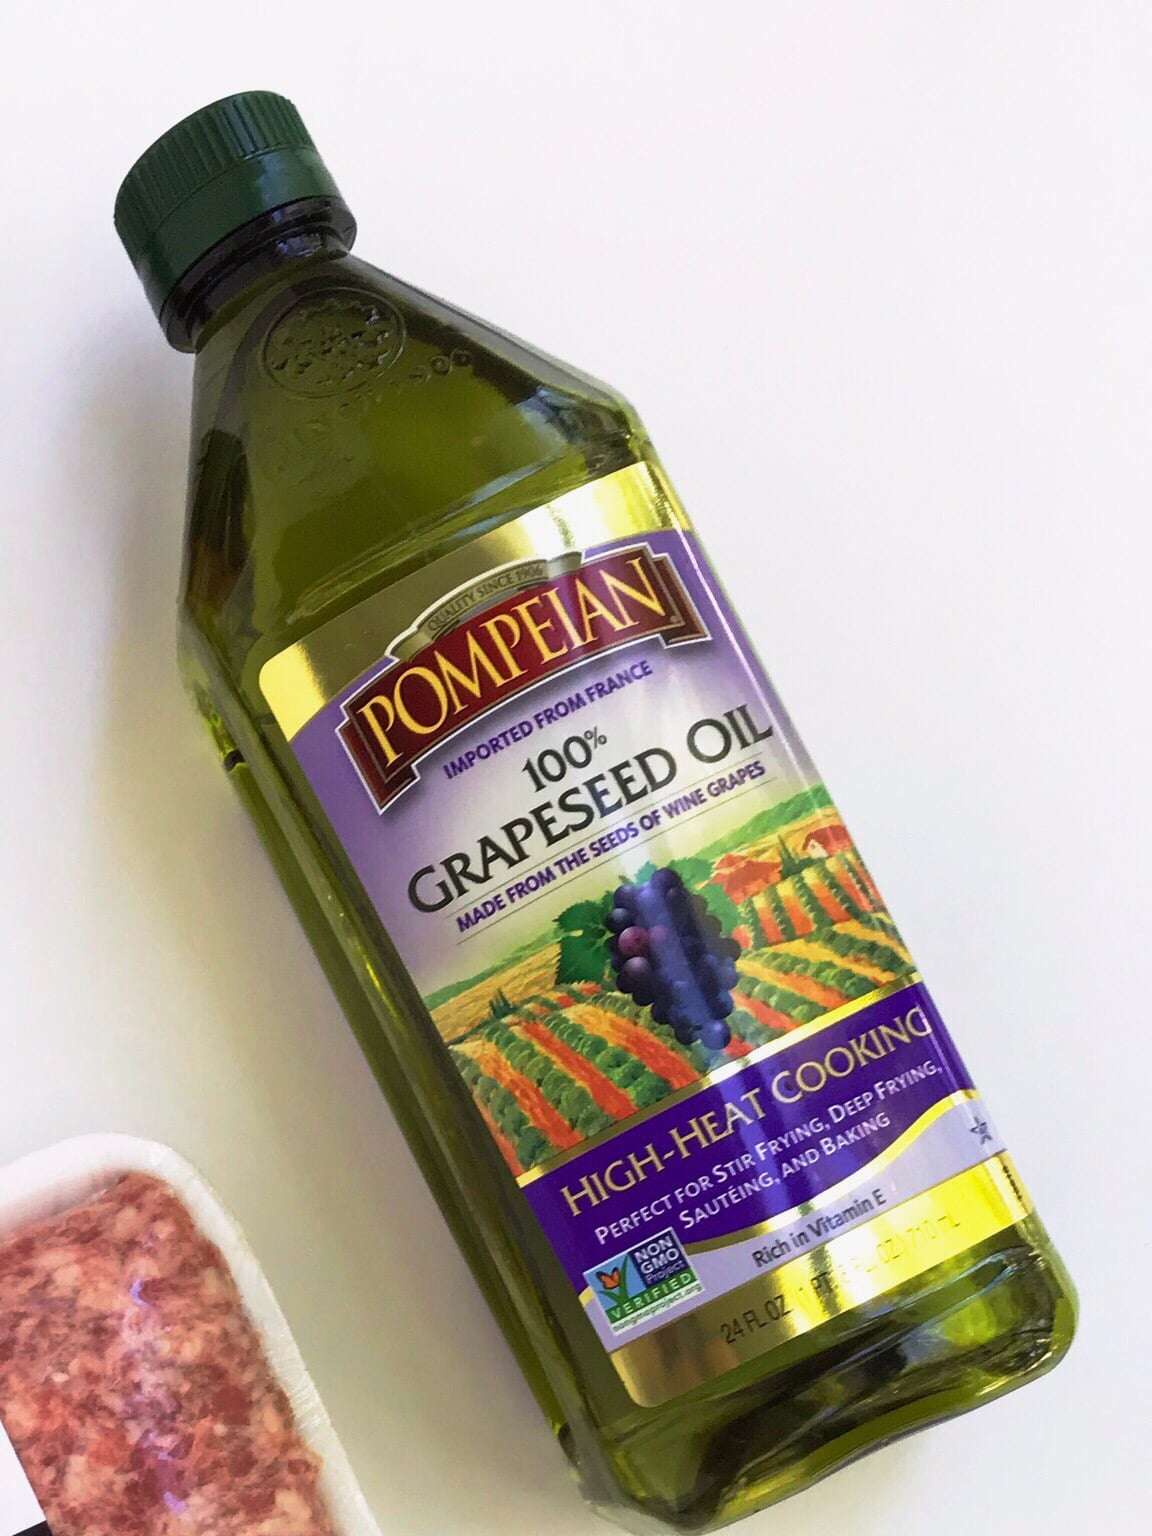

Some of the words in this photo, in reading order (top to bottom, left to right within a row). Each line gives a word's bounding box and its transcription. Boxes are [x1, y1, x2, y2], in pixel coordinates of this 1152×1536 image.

[425, 588, 479, 632] QUALITY
[477, 573, 516, 601] SINCE
[358, 559, 665, 766] POMPEIAN
[443, 721, 532, 779] IMPORTED
[534, 694, 586, 729] FROM
[585, 660, 652, 702] FRANCE
[522, 728, 606, 792] 100%
[407, 748, 676, 913] GRAPESEED
[688, 704, 773, 763] OIL
[456, 894, 506, 932] MADE
[506, 867, 556, 903] FROM
[554, 848, 590, 874] THE
[589, 822, 639, 857] SEEDS
[640, 810, 660, 830] OF
[662, 788, 707, 818] WINE
[707, 760, 765, 797] GRAPES
[560, 1088, 766, 1216] HIGH-HEAT
[771, 1004, 933, 1105] COOKING
[634, 1236, 672, 1262] NON
[752, 1241, 790, 1267] Rich
[792, 1232, 810, 1247] in
[806, 1200, 874, 1237] Vitamin
[872, 1189, 886, 1206] E
[641, 1248, 679, 1273] GMO
[645, 1260, 685, 1284] Project
[611, 1273, 691, 1318] VERIFIED
[721, 1319, 744, 1344] 24
[743, 1310, 768, 1332] FL
[764, 1292, 792, 1322] OZ
